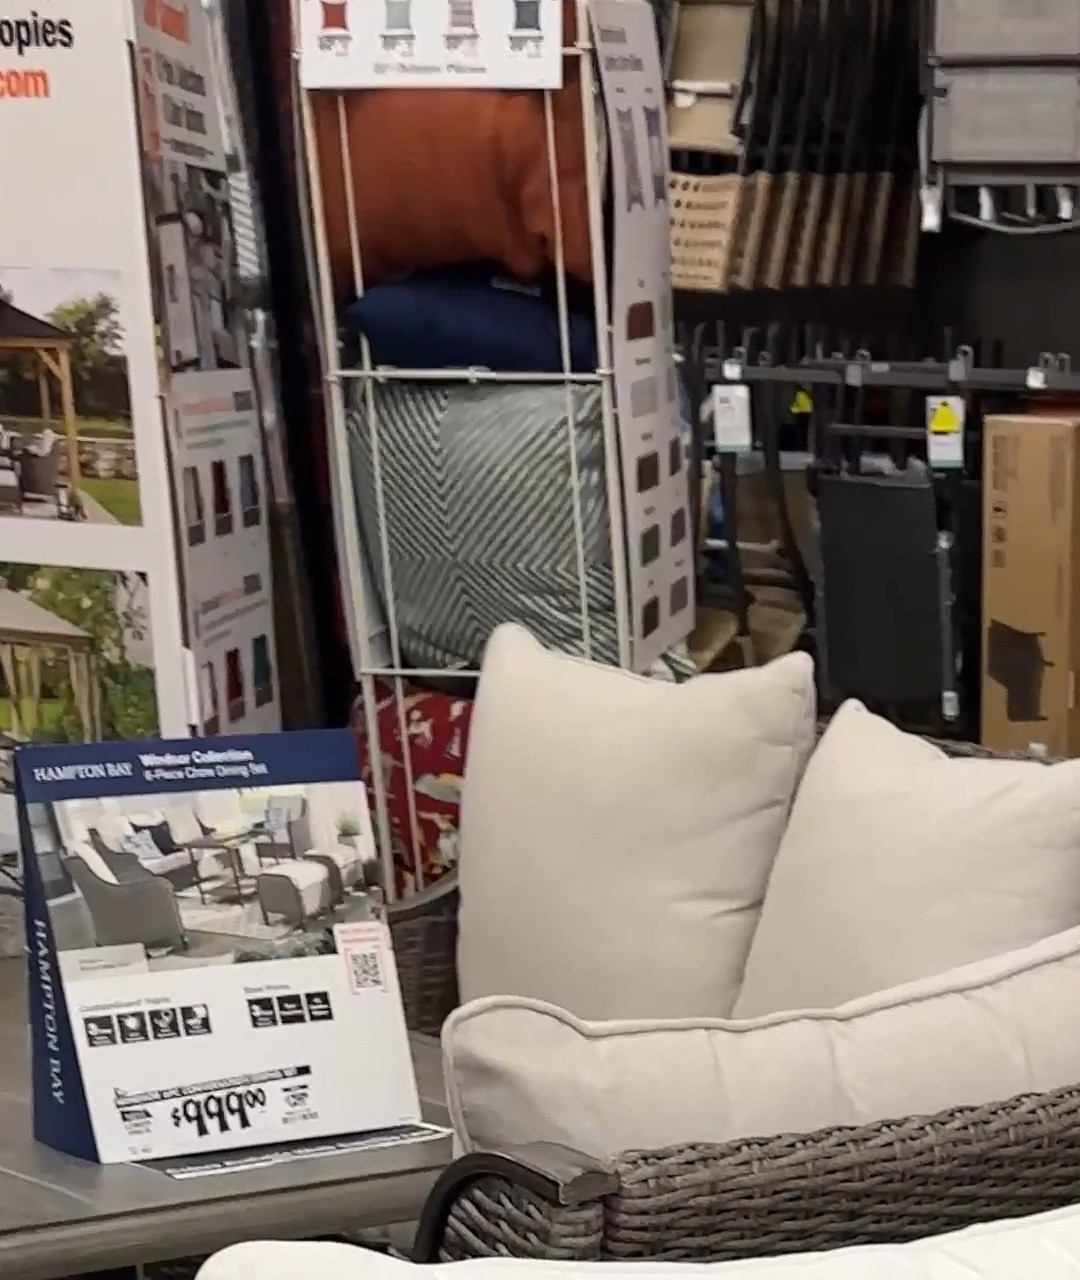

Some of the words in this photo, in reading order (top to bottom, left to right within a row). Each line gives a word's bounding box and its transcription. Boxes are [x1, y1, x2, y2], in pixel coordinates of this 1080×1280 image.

[33, 764, 107, 782] HAMPTON
[107, 762, 133, 777] BAY
[33, 919, 60, 1052] HAMPTON
